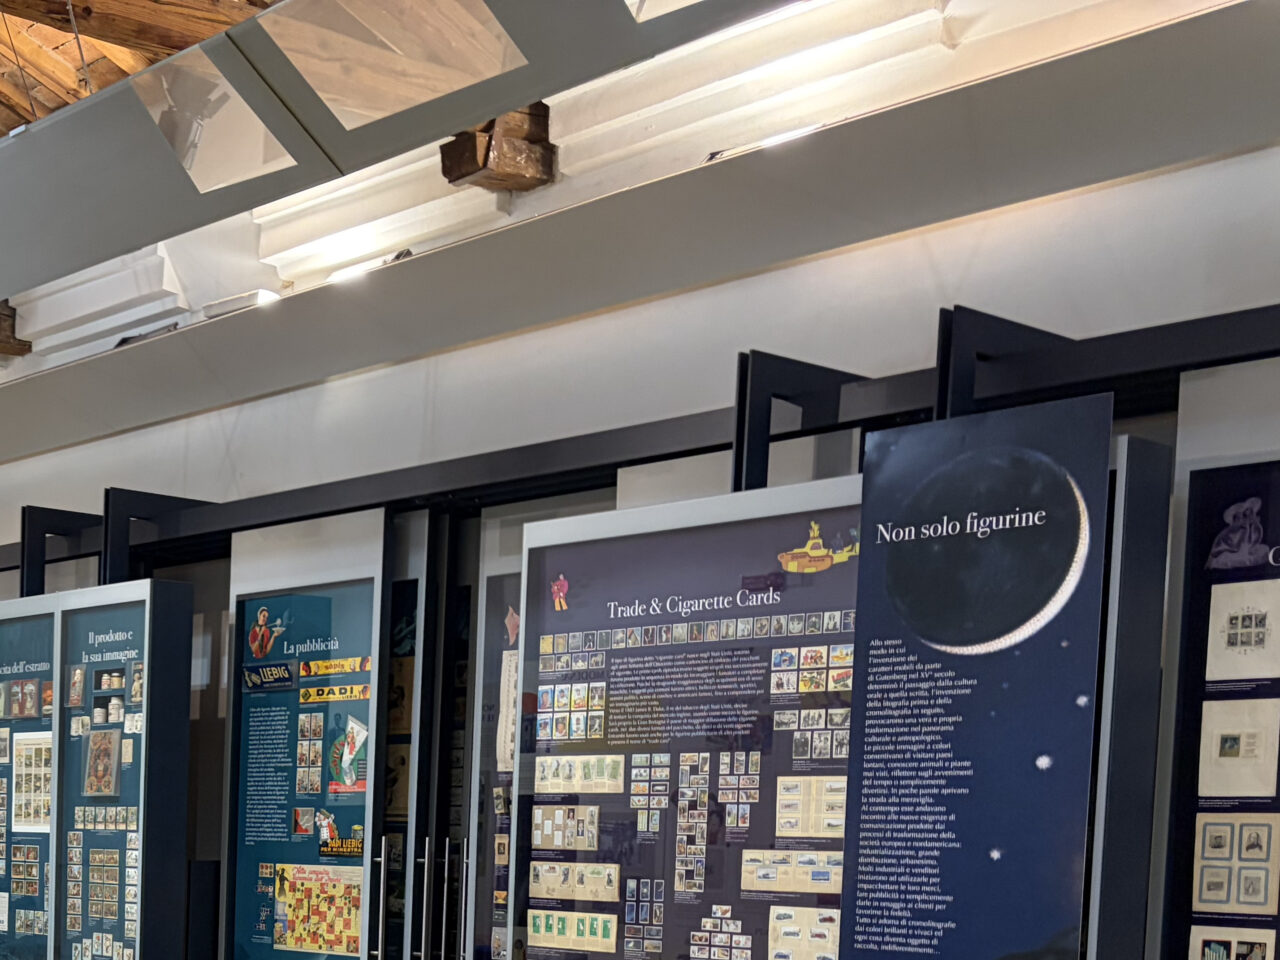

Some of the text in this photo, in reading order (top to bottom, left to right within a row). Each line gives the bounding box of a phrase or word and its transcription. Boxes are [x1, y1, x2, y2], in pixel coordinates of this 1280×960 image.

[876, 506, 1047, 544] Non solo figurine
[607, 587, 781, 619] Trade & Cigarette Cards
[88, 629, 133, 647] Il prodotto e
[870, 638, 902, 647] Allo stesso
[283, 636, 339, 657] La pubblicità
[82, 646, 139, 663] la sua immagine
[869, 655, 906, 664] l'invenzione
[868, 665, 893, 673] caratteri
[925, 662, 941, 672] parte
[259, 665, 289, 682] LIEBIG
[934, 670, 955, 678] secolo
[868, 678, 977, 690] determinò passaggio dalla cultura
[316, 685, 354, 697] DADI
[867, 688, 971, 699] orale quella scritta, l'invenzione
[910, 698, 929, 707] prima
[936, 697, 952, 705] della
[921, 706, 945, 716] seguito,
[939, 715, 962, 724] propria
[865, 725, 909, 733] trasformazione
[865, 733, 942, 743] culturale antropologico.
[873, 743, 895, 752] piccole
[897, 743, 925, 752] immagini
[936, 751, 953, 760] paesi
[863, 761, 886, 769] lontani,
[951, 760, 971, 768] piante
[876, 769, 889, 778] visti,
[918, 769, 933, 778] sugli
[873, 778, 892, 787] tempo
[900, 778, 946, 787] semplicemente
[899, 787, 918, 795] poche
[919, 787, 939, 795] parole
[941, 787, 969, 795] aprivano
[901, 796, 934, 804] meraviglia.
[869, 804, 900, 813] contempo
[920, 813, 947, 822] esigenze
[860, 821, 906, 829] comunicazione
[908, 822, 934, 831] prodotte
[860, 830, 884, 839] processi
[343, 838, 362, 848] LIEBIG
[859, 847, 940, 858] industrializzazione, grande
[858, 856, 898, 866] distribuzione,
[875, 865, 905, 873] industriali
[912, 866, 939, 874] venditori
[858, 873, 888, 881] iniziarono
[857, 882, 899, 892] impacchettare
[921, 884, 941, 894] merci,
[857, 890, 953, 903] fare pubblicità semplicemente
[880, 900, 906, 910] omaggio
[890, 909, 913, 917] fedeltà.
[856, 916, 871, 924] Tutto
[884, 927, 907, 935] brillanti
[915, 928, 933, 936] vivaci
[855, 934, 868, 943] ogni
[884, 935, 906, 943] diventa
[907, 937, 930, 947] oggetto
[854, 942, 879, 952] raccolta,
